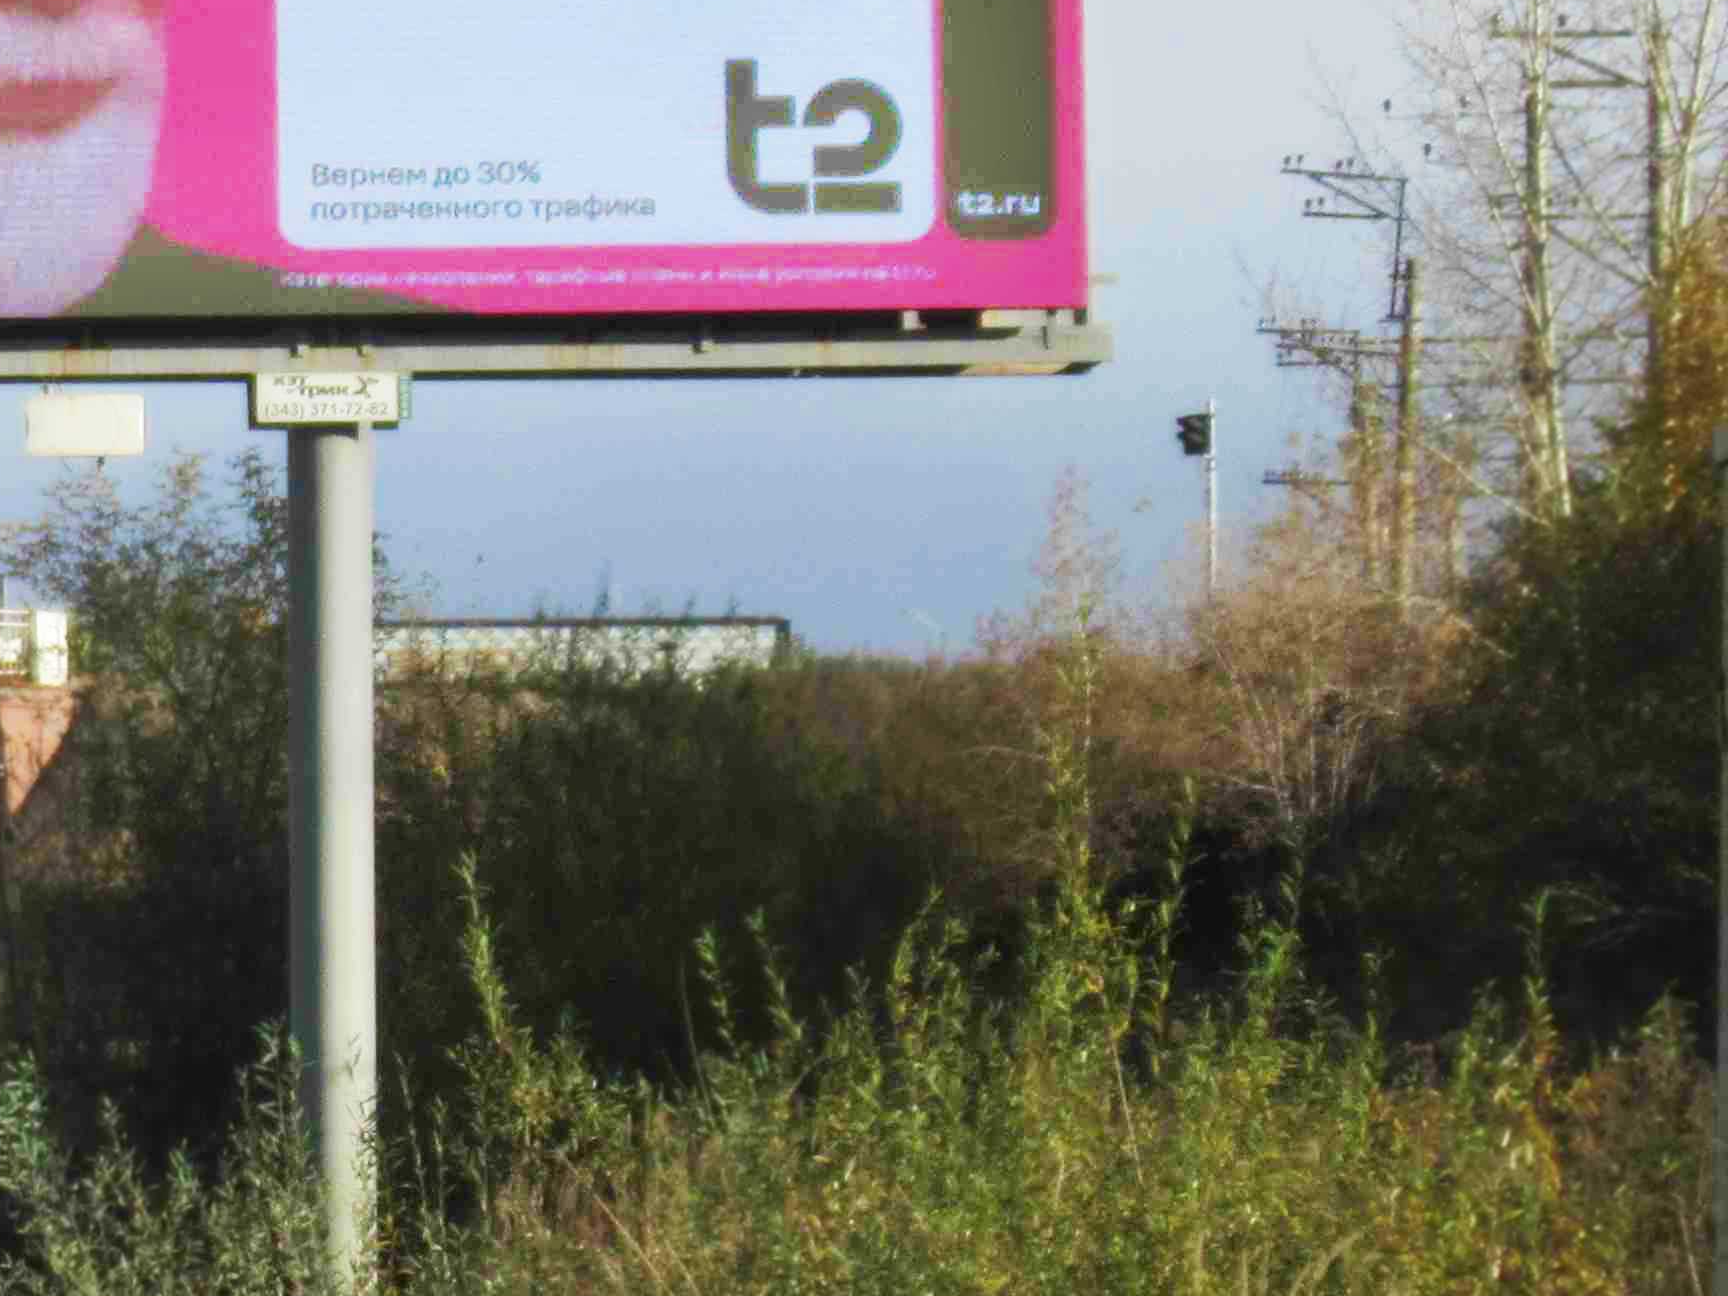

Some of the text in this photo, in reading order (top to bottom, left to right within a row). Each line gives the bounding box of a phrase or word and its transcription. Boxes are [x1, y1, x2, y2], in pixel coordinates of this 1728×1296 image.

[725, 59, 903, 215] t2
[311, 160, 542, 188] Вернем до 30%
[311, 195, 656, 224] потраченного трафика
[957, 191, 1041, 216] t2.ru
